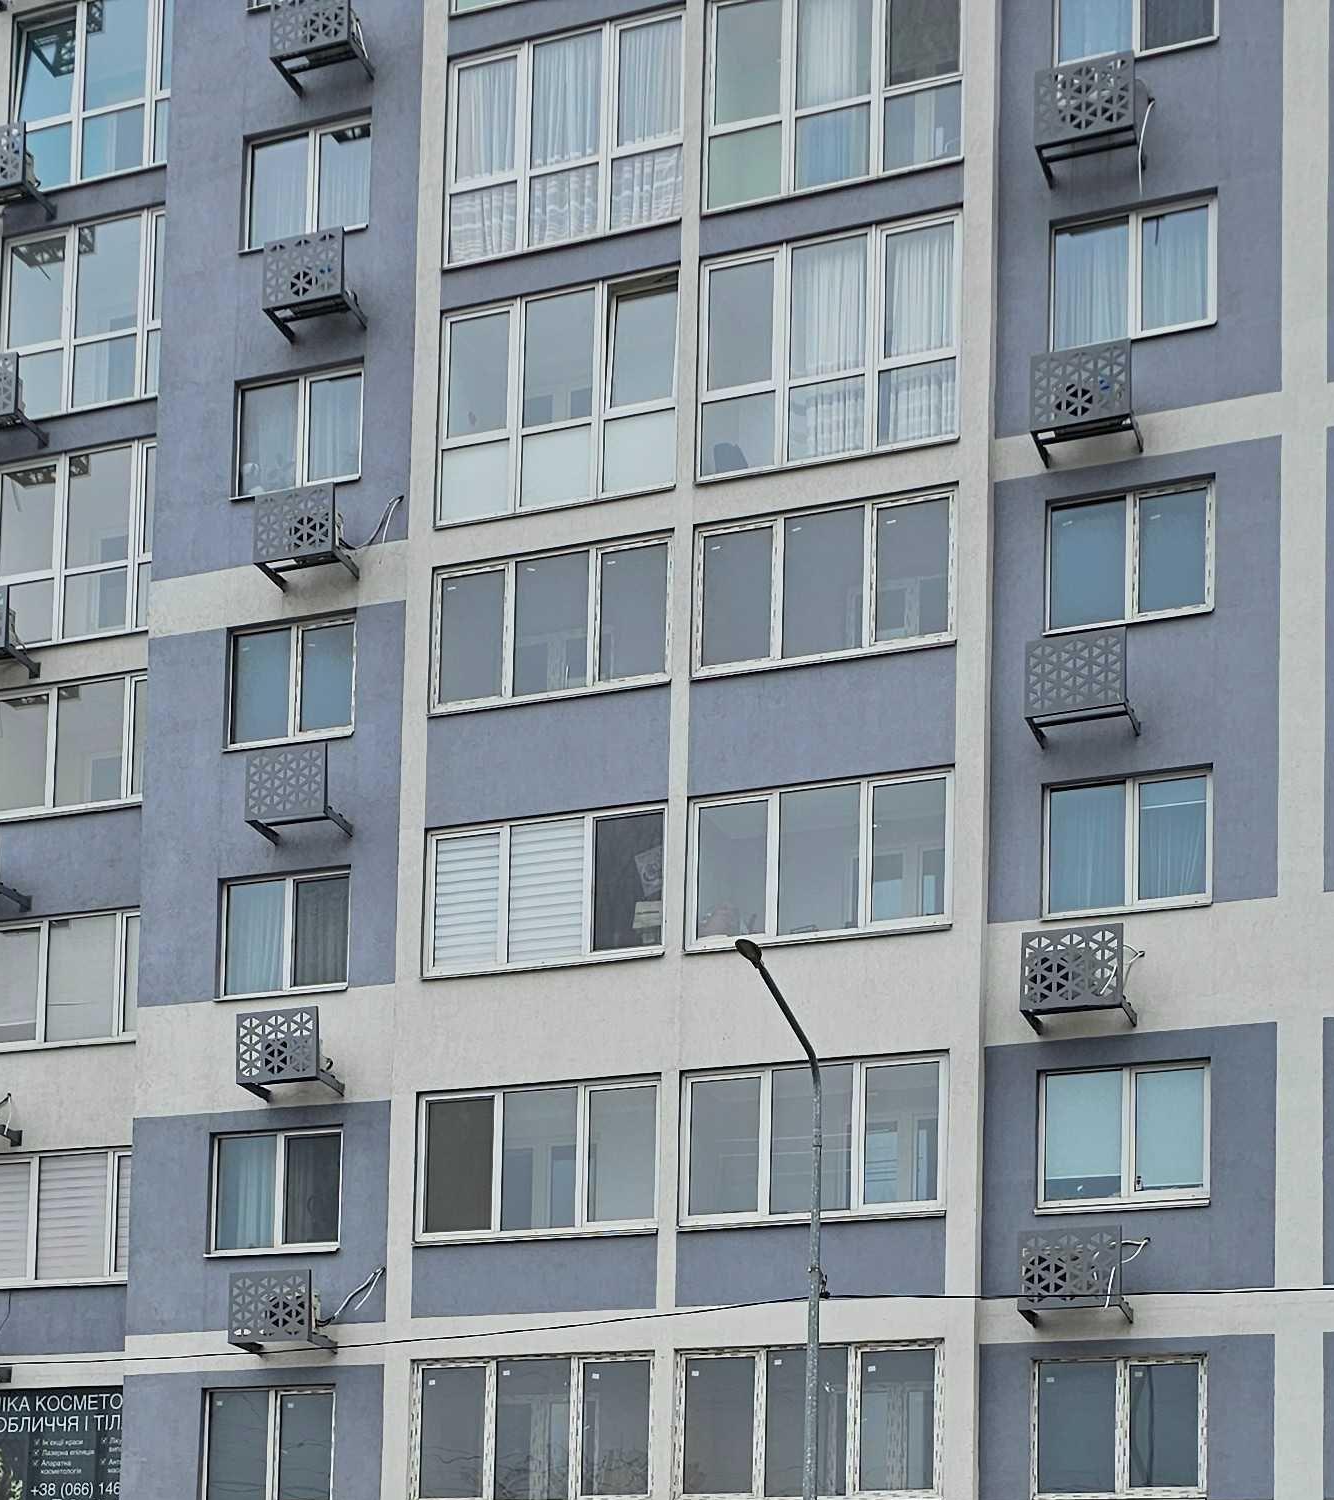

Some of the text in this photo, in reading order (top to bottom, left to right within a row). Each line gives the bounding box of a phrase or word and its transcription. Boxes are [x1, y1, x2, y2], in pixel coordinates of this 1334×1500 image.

[31, 1481, 121, 1498] +38 (066) 146
